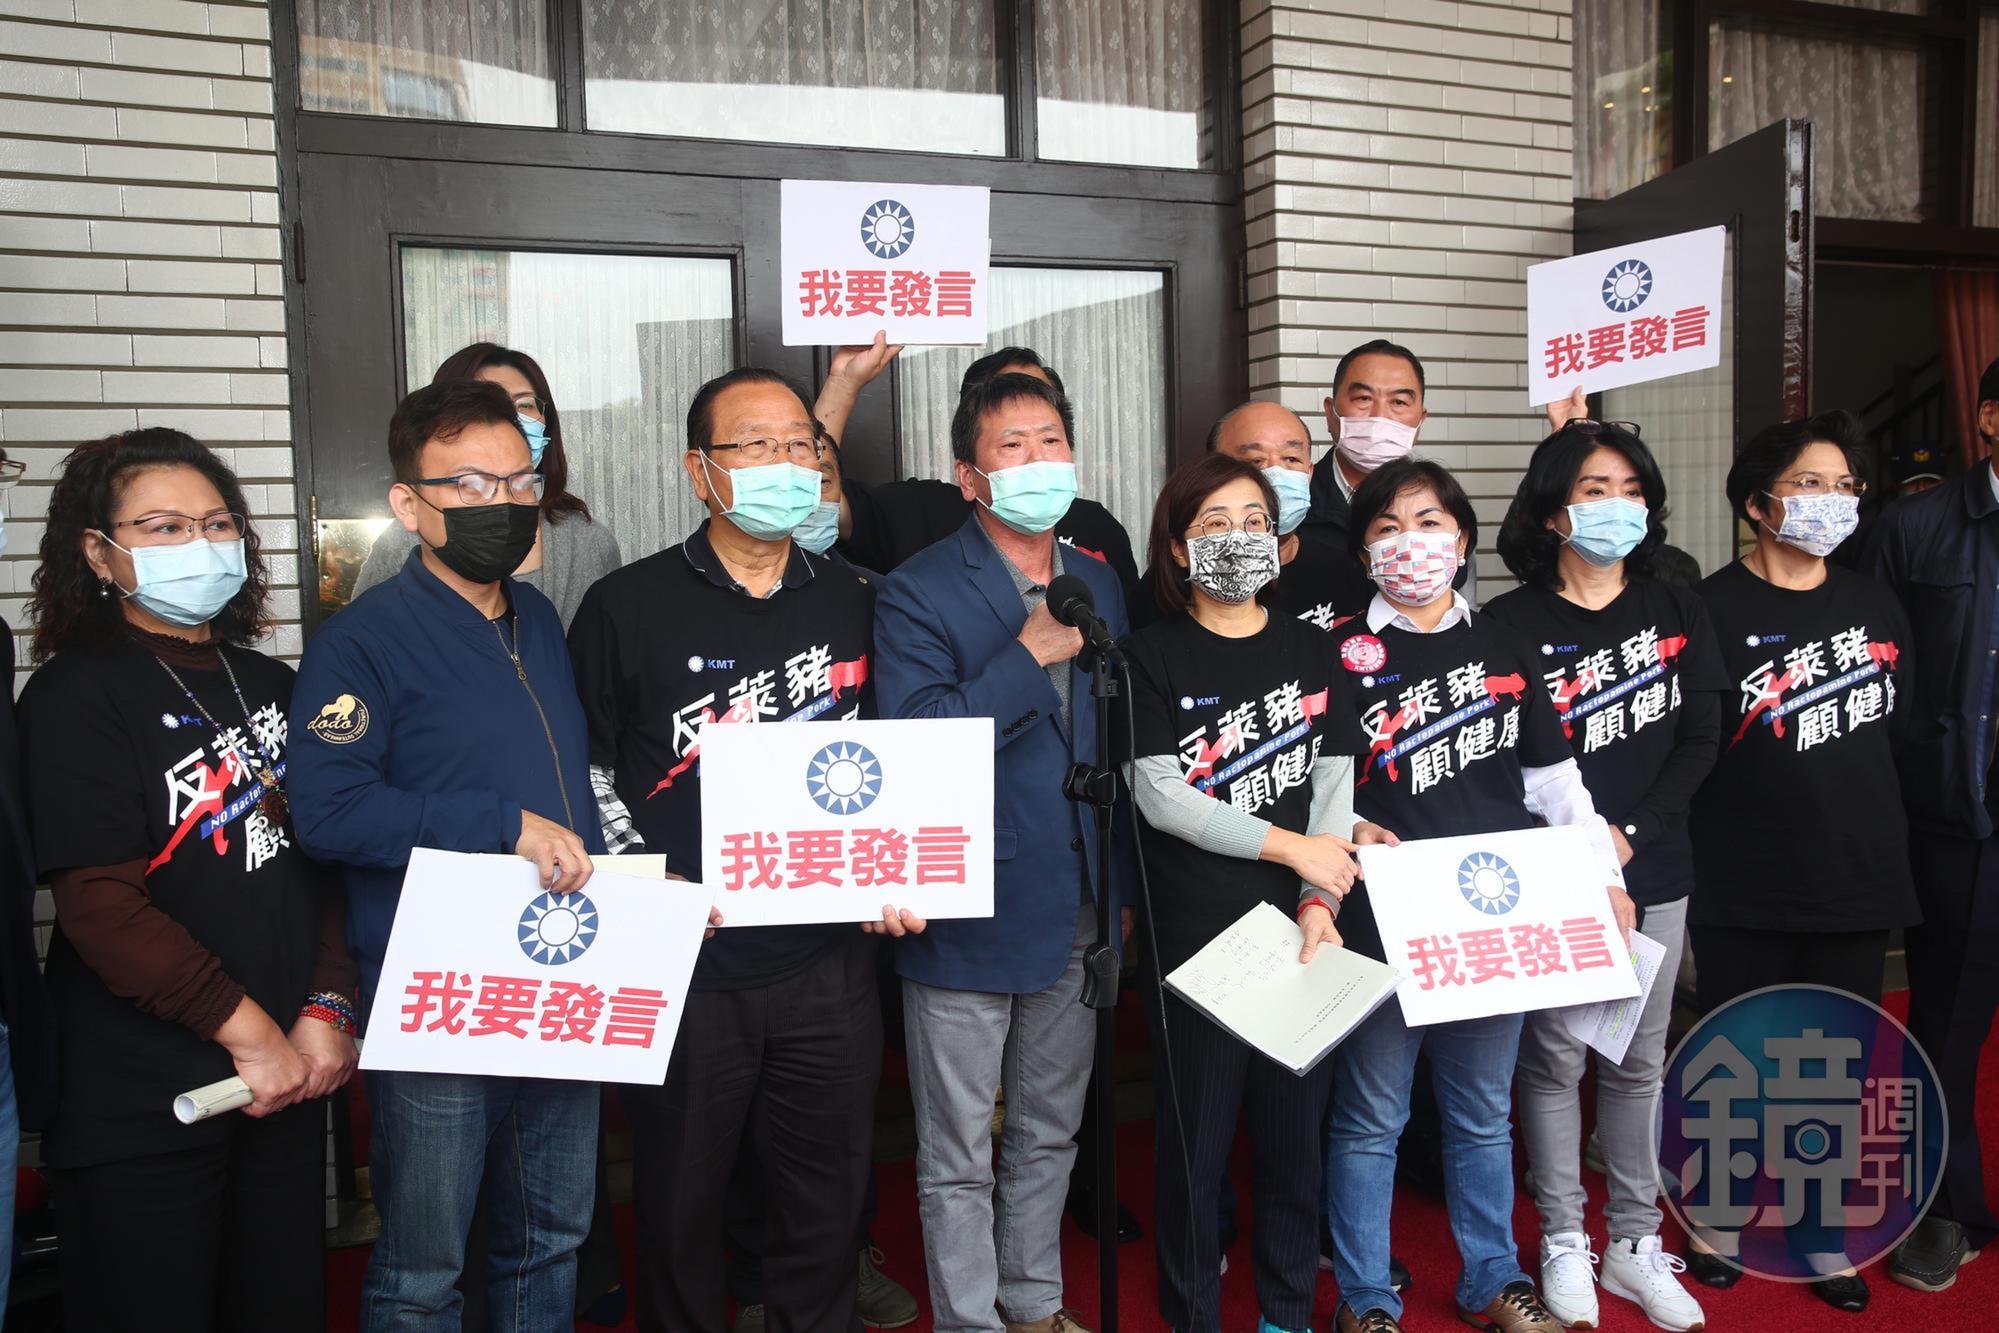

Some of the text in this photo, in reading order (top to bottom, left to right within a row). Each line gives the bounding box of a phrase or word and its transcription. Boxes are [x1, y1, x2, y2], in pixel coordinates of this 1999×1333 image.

[799, 269, 976, 317] 我要發言
[1545, 305, 1710, 378] 我要發言
[708, 659, 736, 669] KMT
[1556, 644, 1579, 653] KMT
[1763, 634, 1787, 643] KMT
[1378, 673, 1402, 685] KMT
[1560, 665, 1662, 723] NO Ractopamine Pork
[1740, 626, 1872, 714] 反萊豬
[1770, 665, 1875, 719] NO Ractopamine Pork
[307, 714, 353, 730] dodo
[807, 698, 831, 716] Pork
[1197, 696, 1220, 706] KMT
[1360, 661, 1489, 749] 反萊豬
[1203, 776, 1216, 788] NO
[1284, 723, 1306, 742] Pork
[1384, 700, 1490, 763] NO Ractopamine Pork
[211, 811, 227, 830] NO
[721, 826, 970, 890] 我要發言
[1407, 916, 1614, 991] 我要發言
[400, 971, 667, 1049] 我要發言
